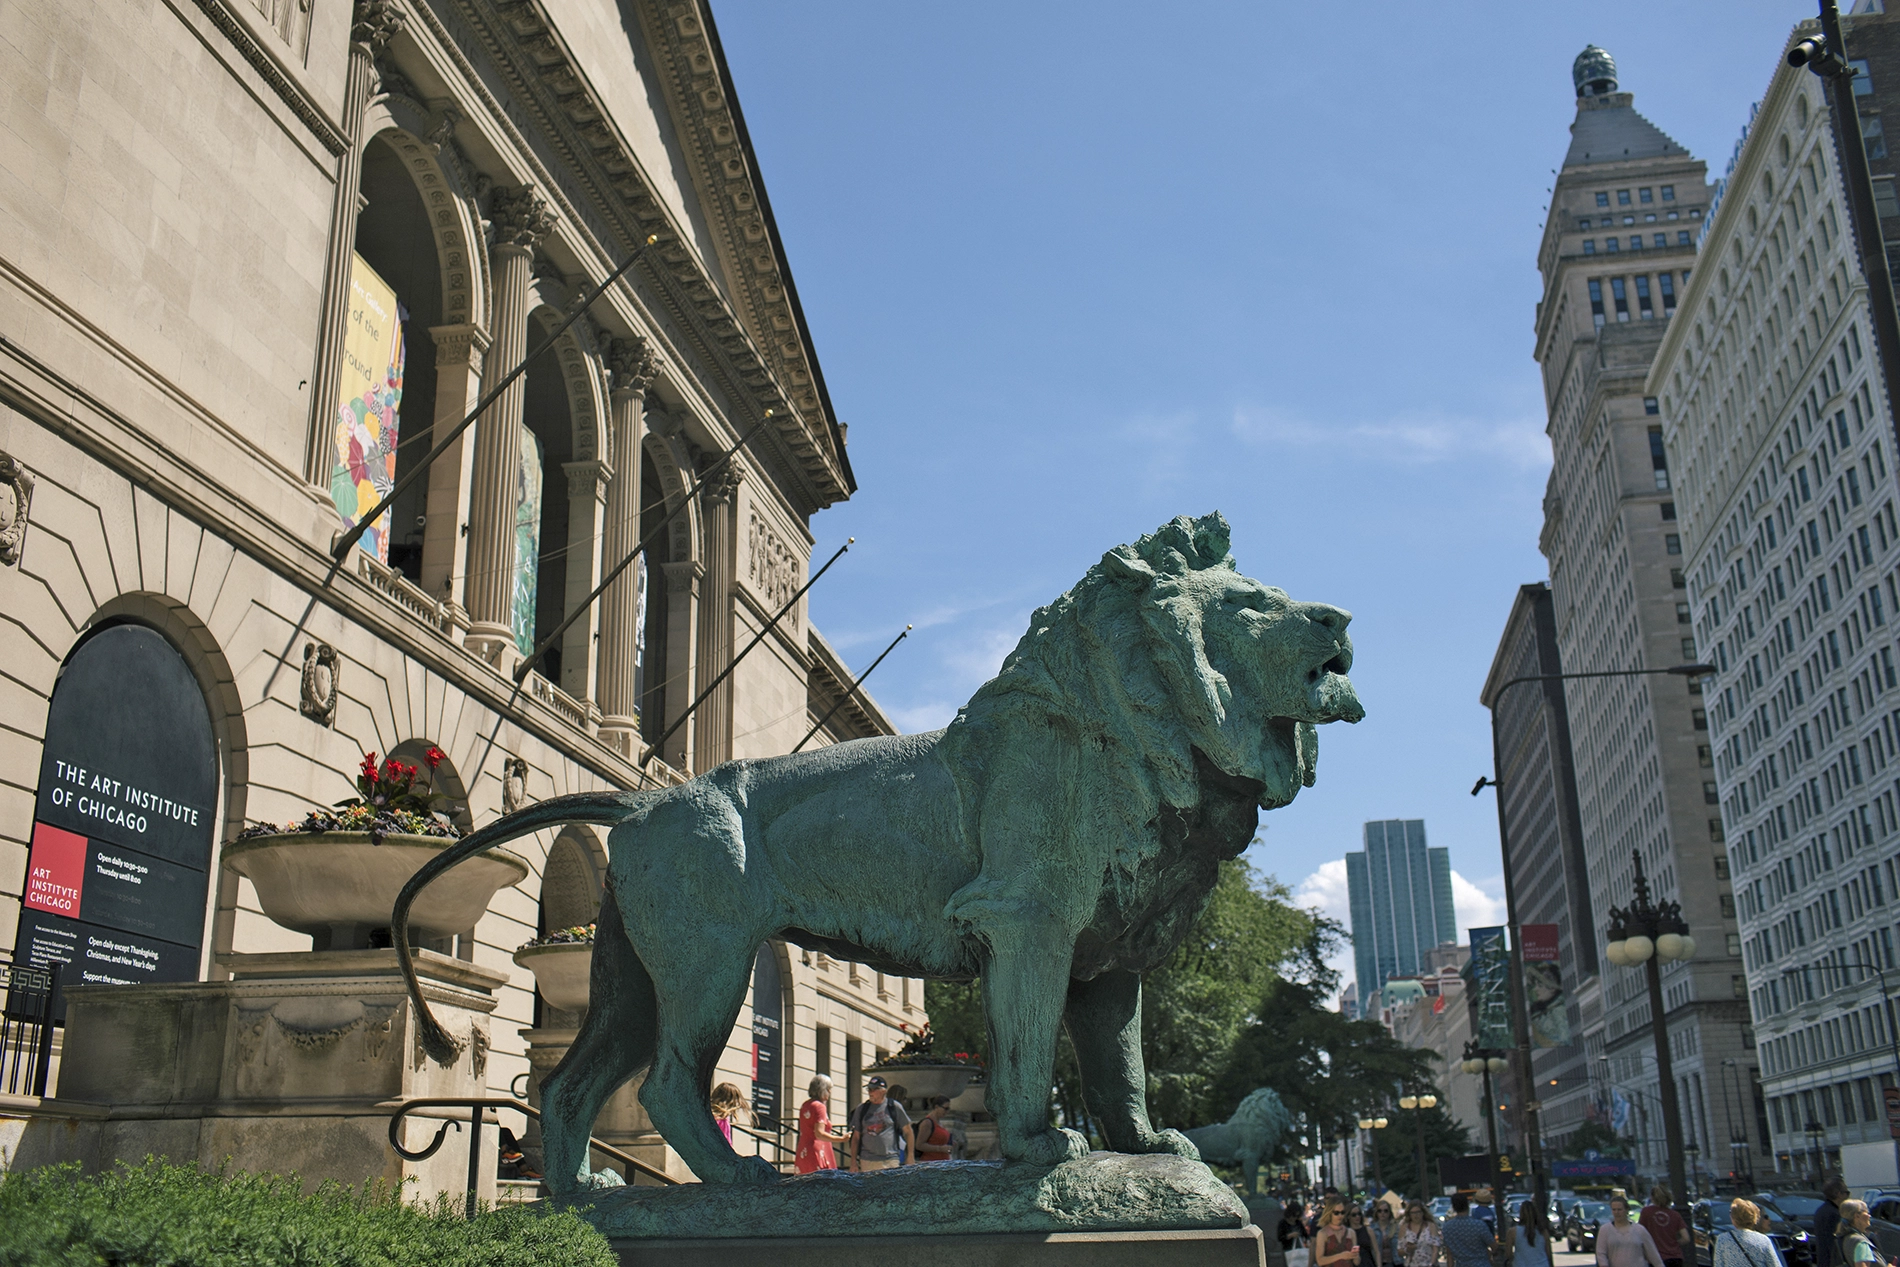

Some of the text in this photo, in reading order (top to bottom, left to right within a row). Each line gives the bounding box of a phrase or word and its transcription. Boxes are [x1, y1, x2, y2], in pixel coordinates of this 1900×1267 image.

[352, 308, 364, 325] of
[364, 319, 380, 342] the
[343, 347, 373, 382] round
[56, 760, 198, 827] THE ART INSTITUTE
[52, 788, 148, 834] OF CHICAGO
[98, 852, 112, 863] Open
[112, 856, 124, 868] daily
[32, 867, 51, 880] ART
[96, 864, 119, 880] Thursday
[119, 873, 130, 882] until
[32, 879, 78, 900] INSTITVTE
[30, 891, 72, 910] CHICAGO
[88, 936, 102, 947] Open
[103, 940, 114, 950] daily
[114, 944, 130, 954] except
[112, 956, 121, 964] and
[121, 956, 132, 966] New
[146, 962, 156, 972] days
[82, 970, 102, 982] Support
[103, 974, 111, 983] the
[1482, 932, 1508, 1034] MANET
